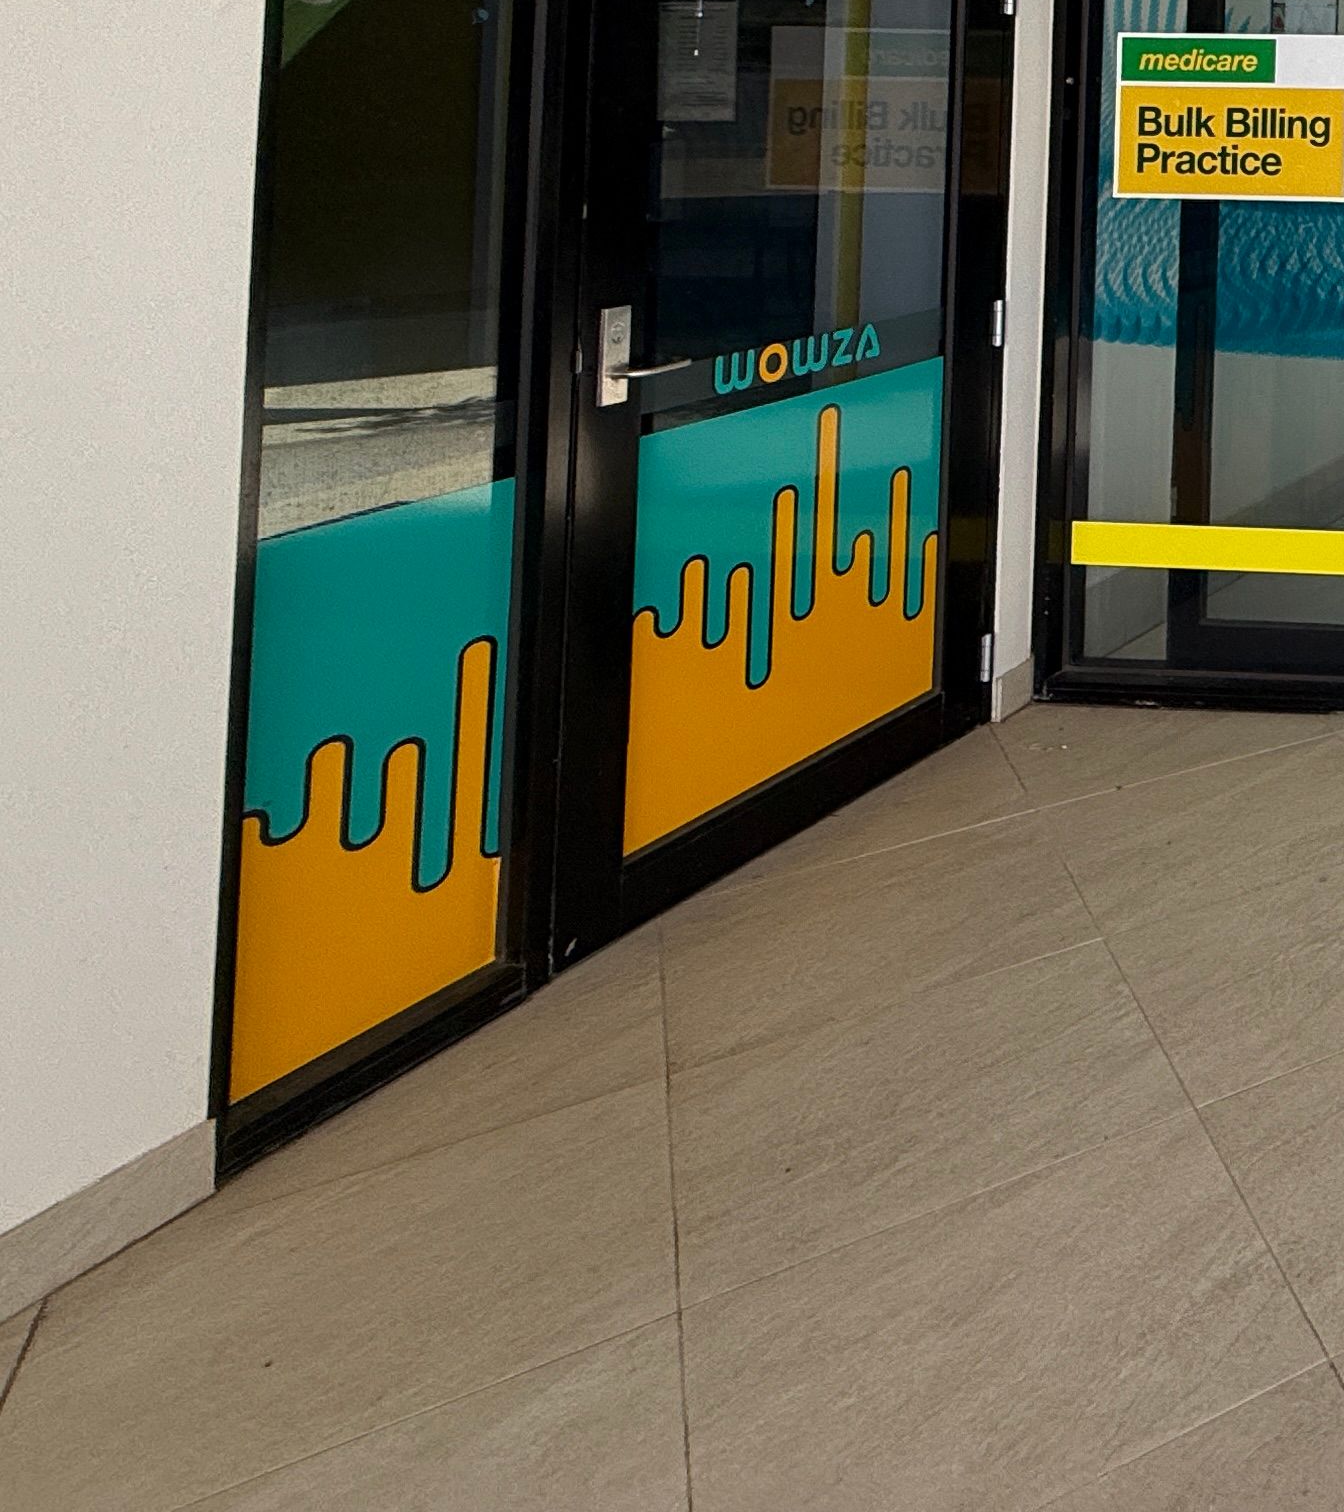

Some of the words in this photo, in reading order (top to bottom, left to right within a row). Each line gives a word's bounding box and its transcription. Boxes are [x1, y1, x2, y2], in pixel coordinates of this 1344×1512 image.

[1139, 49, 1258, 72] medicare
[1138, 106, 1216, 138] Bulk
[1226, 108, 1331, 147] Billing
[1137, 143, 1282, 175] Practice
[713, 321, 882, 395] WOWZA
